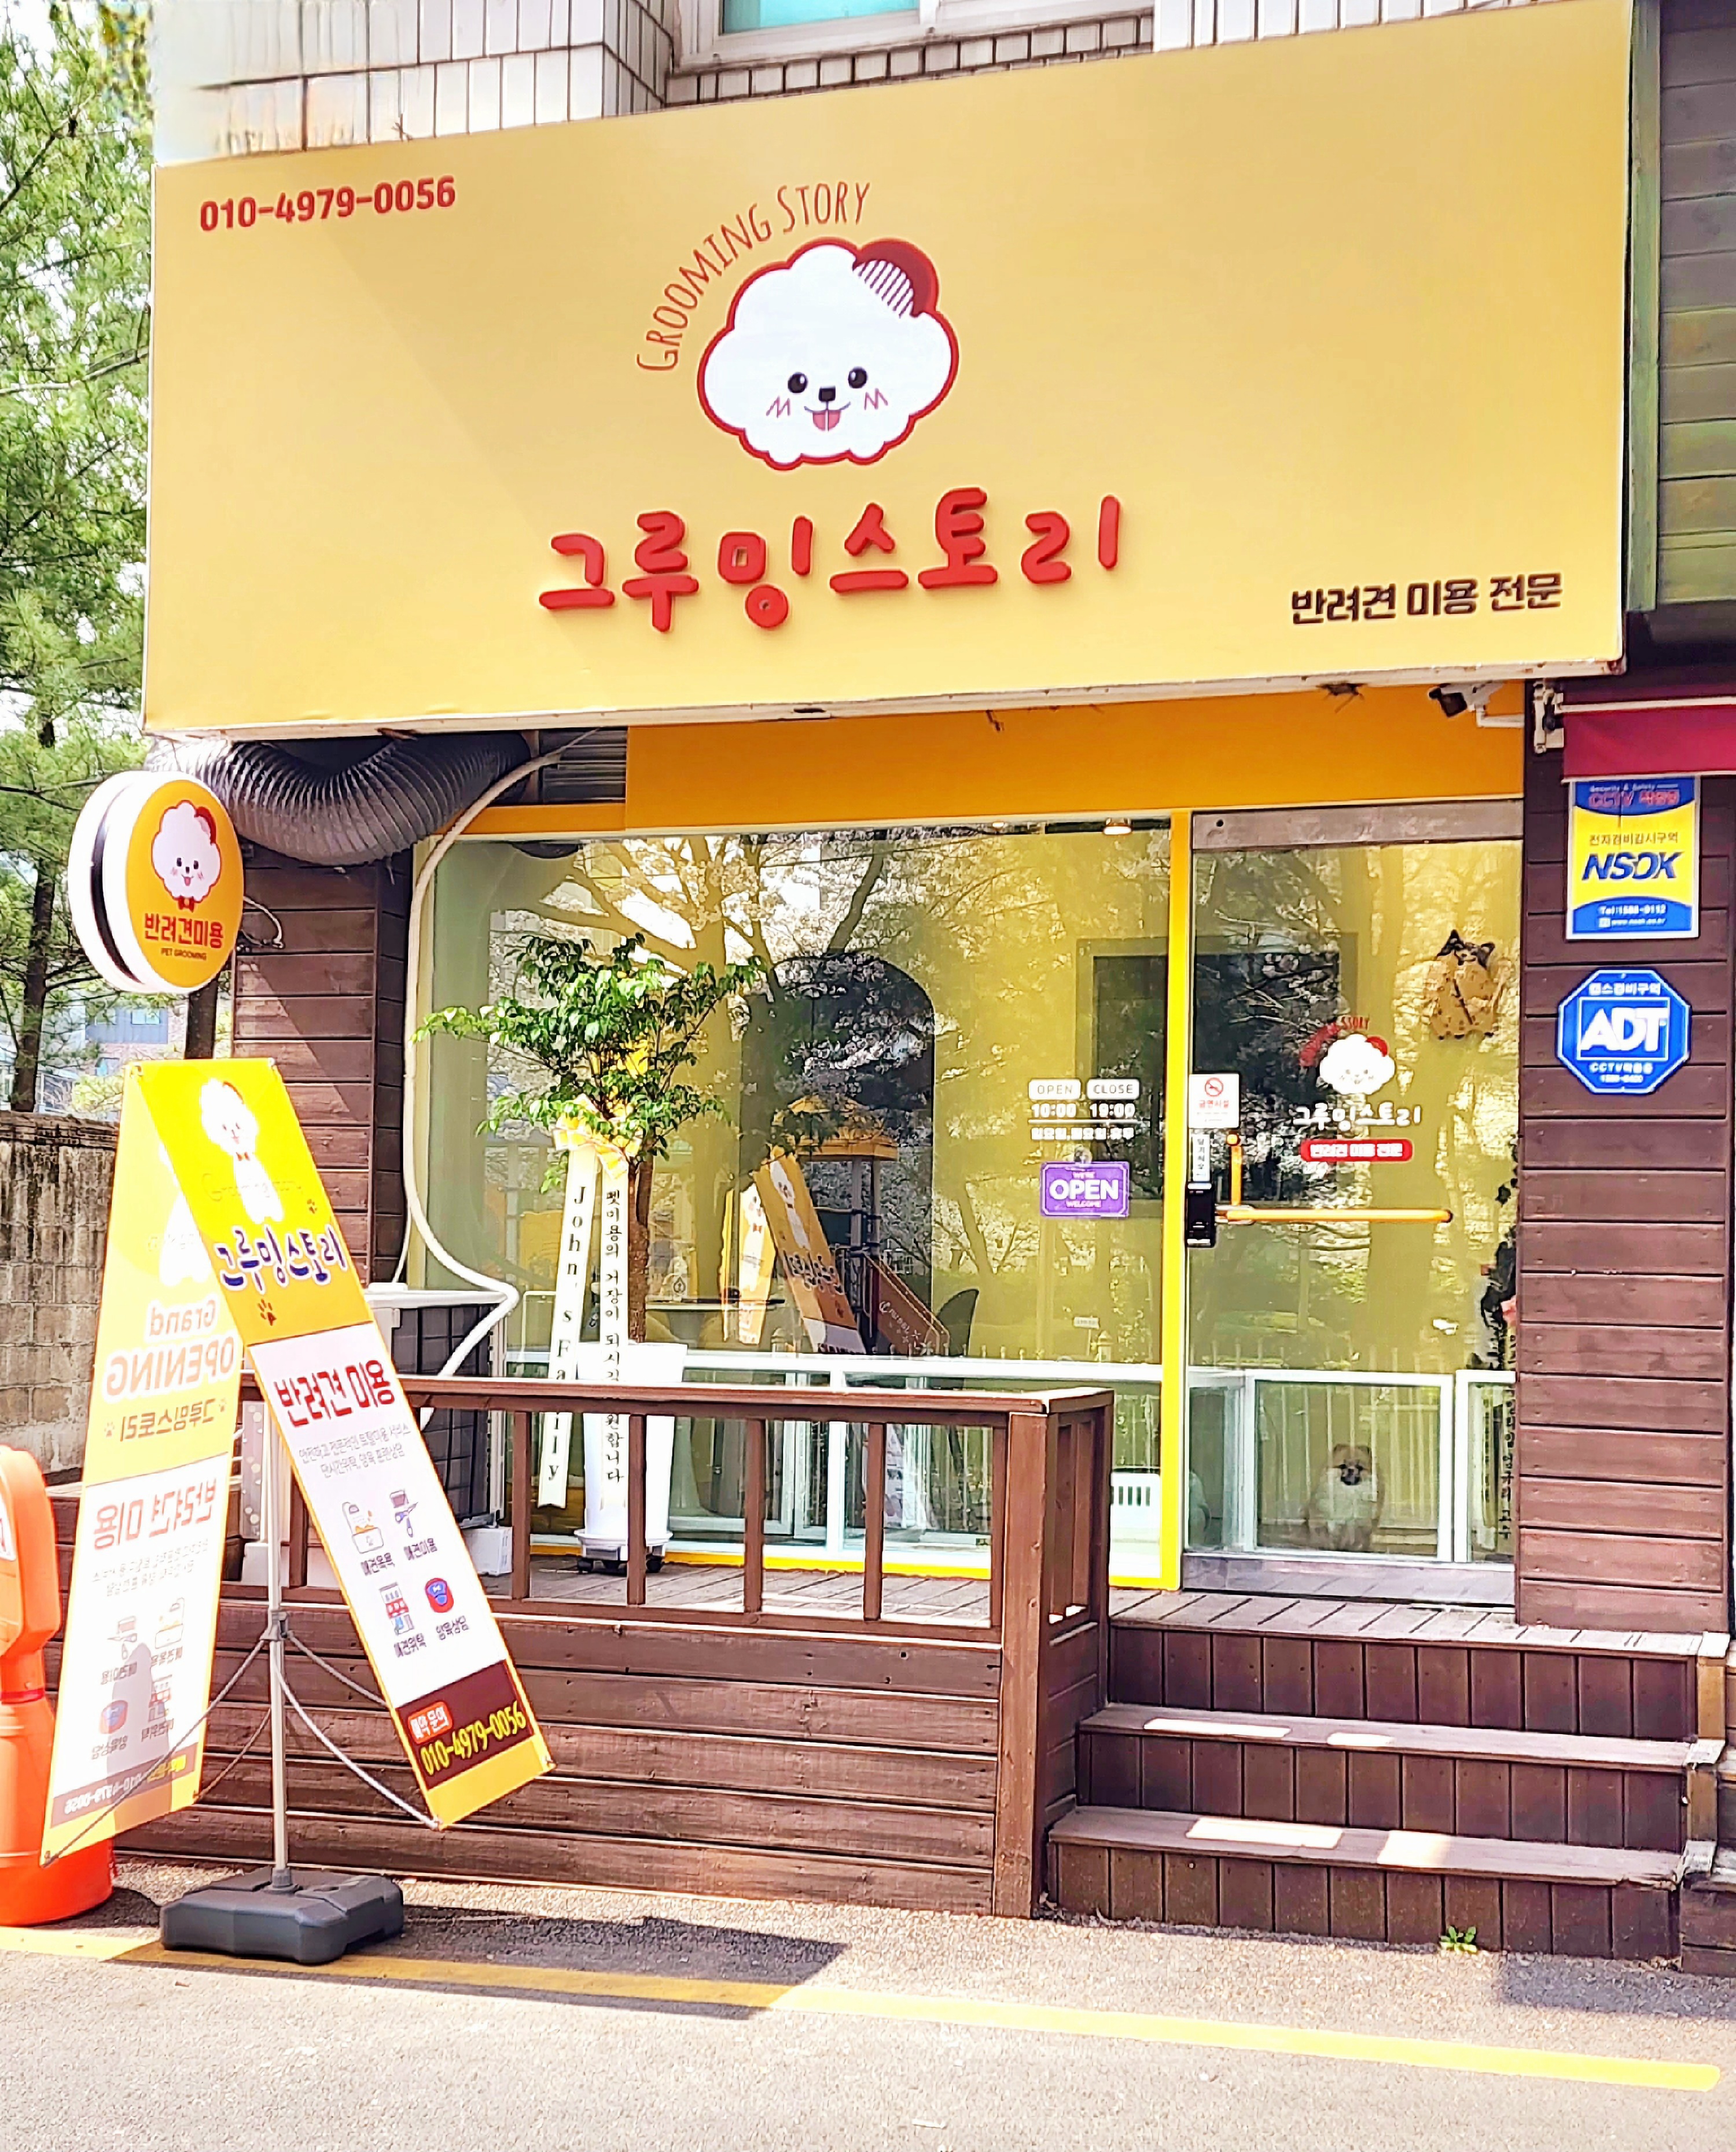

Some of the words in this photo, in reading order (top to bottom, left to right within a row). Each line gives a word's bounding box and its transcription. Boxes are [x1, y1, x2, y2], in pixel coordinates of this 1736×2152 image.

[200, 174, 457, 232] 010-4979-0056
[636, 203, 773, 372] GROOMING
[777, 181, 870, 234] STORY
[539, 486, 1122, 633] 그루밍스토리
[1292, 582, 1396, 625] 반려견
[1407, 578, 1479, 616] 미용
[1489, 572, 1562, 612] 전문
[144, 912, 224, 949] 반려견미용
[1580, 1007, 1669, 1052] ADT
[1031, 1103, 1077, 1118] 10:00
[1090, 1103, 1136, 1118] 19:00
[1037, 1085, 1073, 1095] OPEN
[1093, 1084, 1134, 1094] CLOSE
[1293, 1101, 1422, 1132] 그루밍스토리
[1049, 1179, 1119, 1200] OPEN
[215, 1226, 347, 1292] 그루밍스토리
[274, 1368, 354, 1428] 반려견
[345, 1360, 395, 1408] 미용
[549, 1339, 571, 1481] Faily
[420, 1700, 527, 1776] 010-4979-0056
